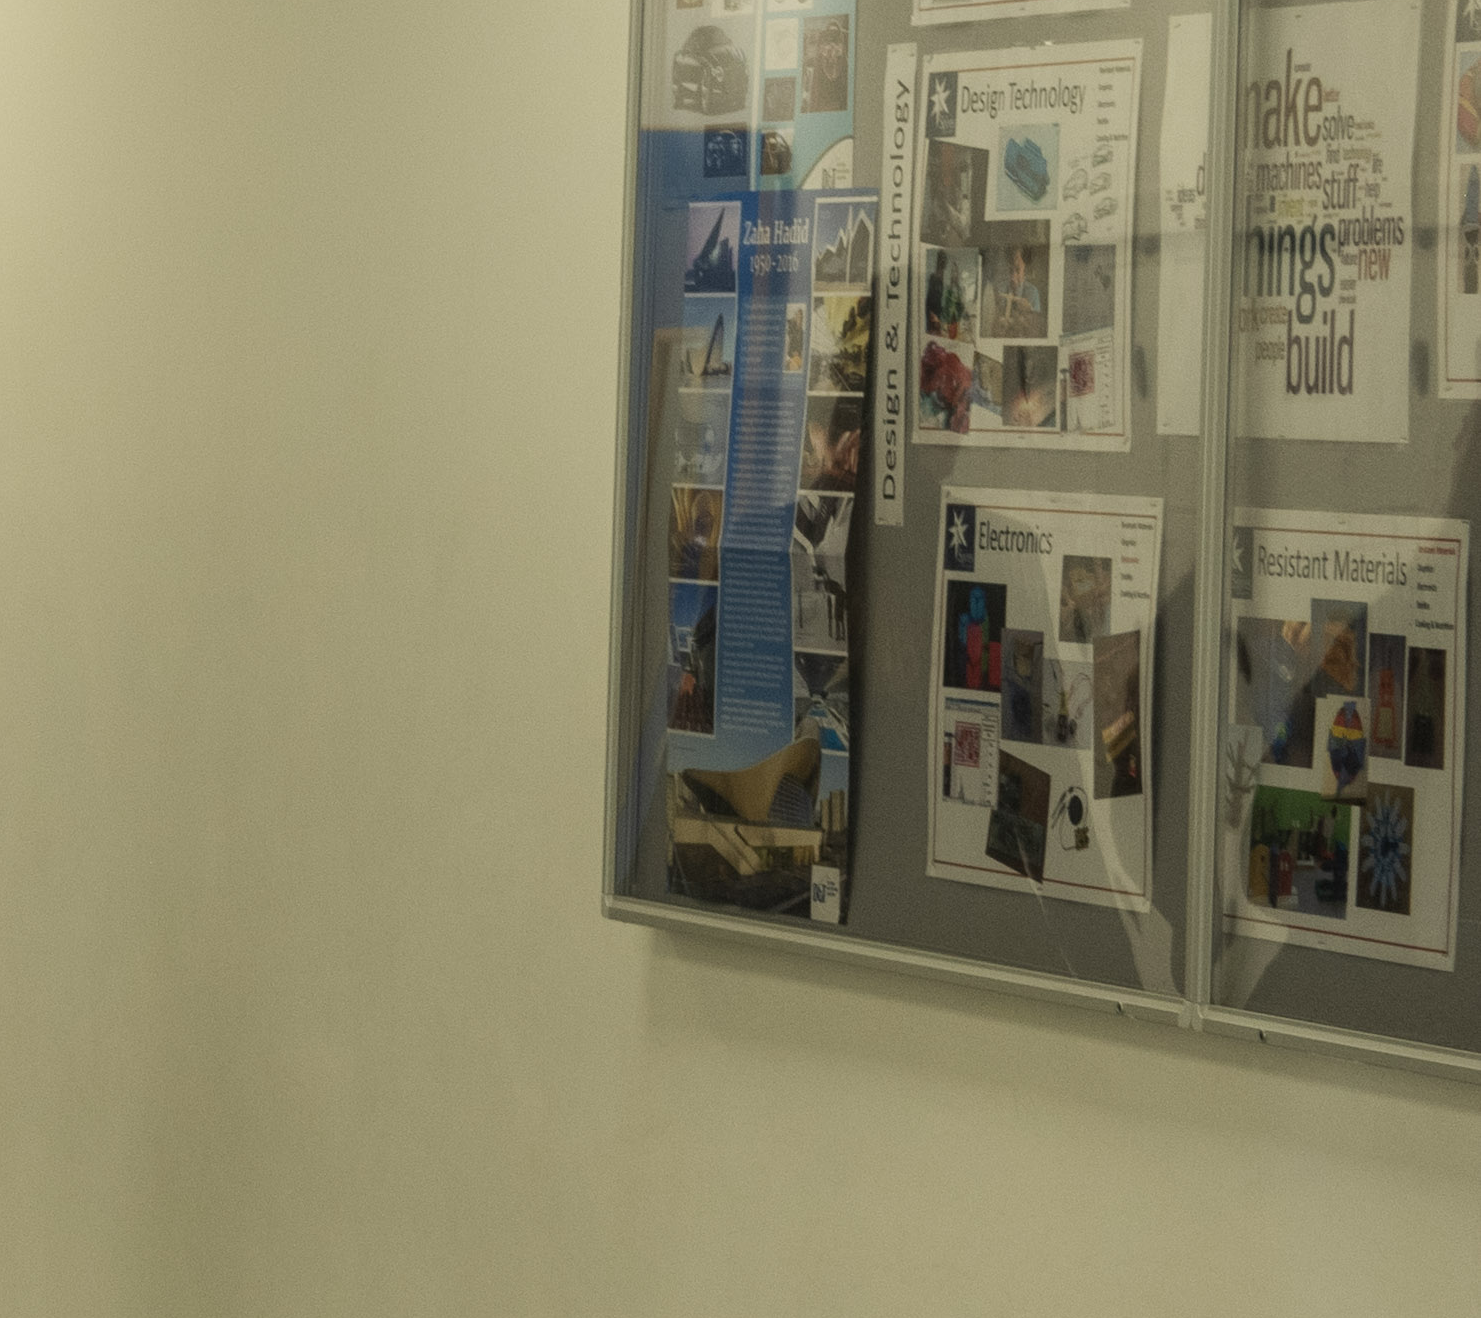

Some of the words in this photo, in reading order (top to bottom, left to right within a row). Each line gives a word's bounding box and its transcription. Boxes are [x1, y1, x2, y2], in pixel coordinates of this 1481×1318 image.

[961, 84, 1005, 119] Design
[1009, 79, 1086, 114] Technology
[1322, 105, 1355, 141] solve
[1257, 151, 1322, 191] machines
[1322, 163, 1359, 210] stuff
[886, 79, 910, 309] Technology
[743, 219, 770, 245] Zaha
[774, 217, 810, 245] Hadid
[1339, 205, 1404, 257] problems
[1359, 248, 1391, 281] new
[885, 322, 899, 353] &
[1286, 309, 1355, 396] build
[883, 368, 900, 500] Design
[978, 520, 1053, 555] Electronics
[1258, 545, 1328, 580] Resistant
[1334, 550, 1407, 586] Materials
